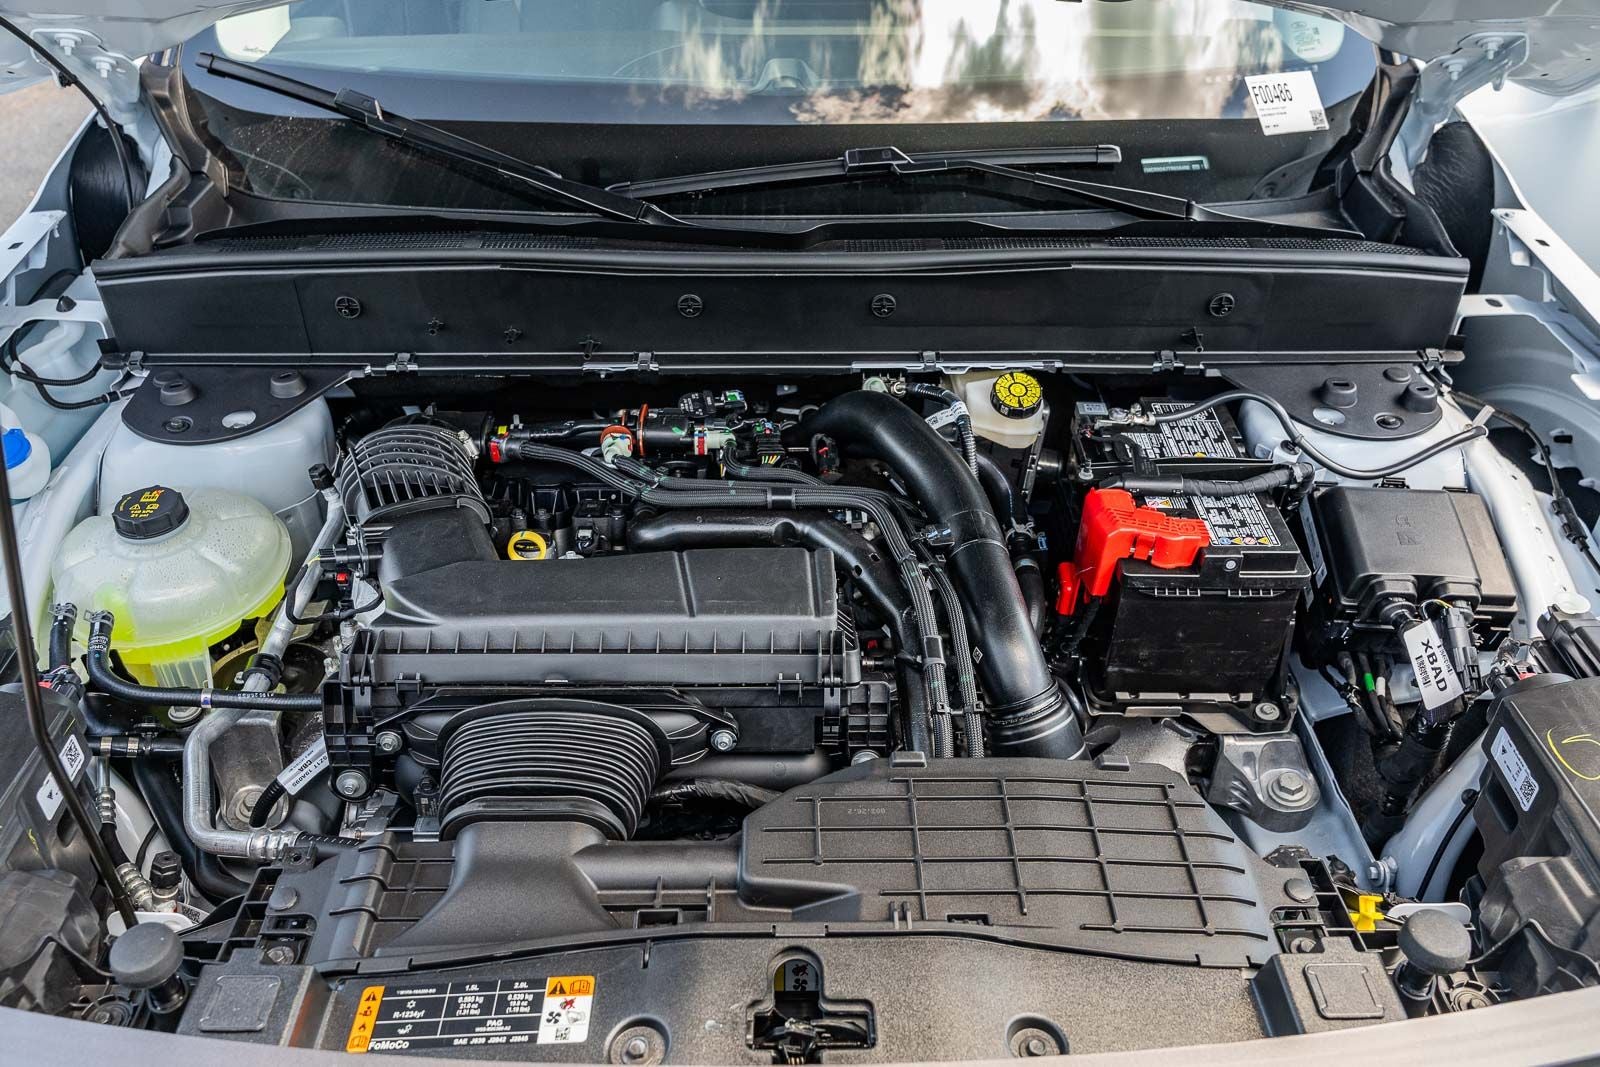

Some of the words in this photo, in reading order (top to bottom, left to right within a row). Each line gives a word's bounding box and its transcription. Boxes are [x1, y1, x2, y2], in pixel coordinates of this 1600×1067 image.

[1251, 82, 1293, 105] F00486
[1421, 638, 1447, 691] XBAD
[392, 1010, 426, 1019] R-1234yf
[368, 1040, 410, 1050] FoMoCo
